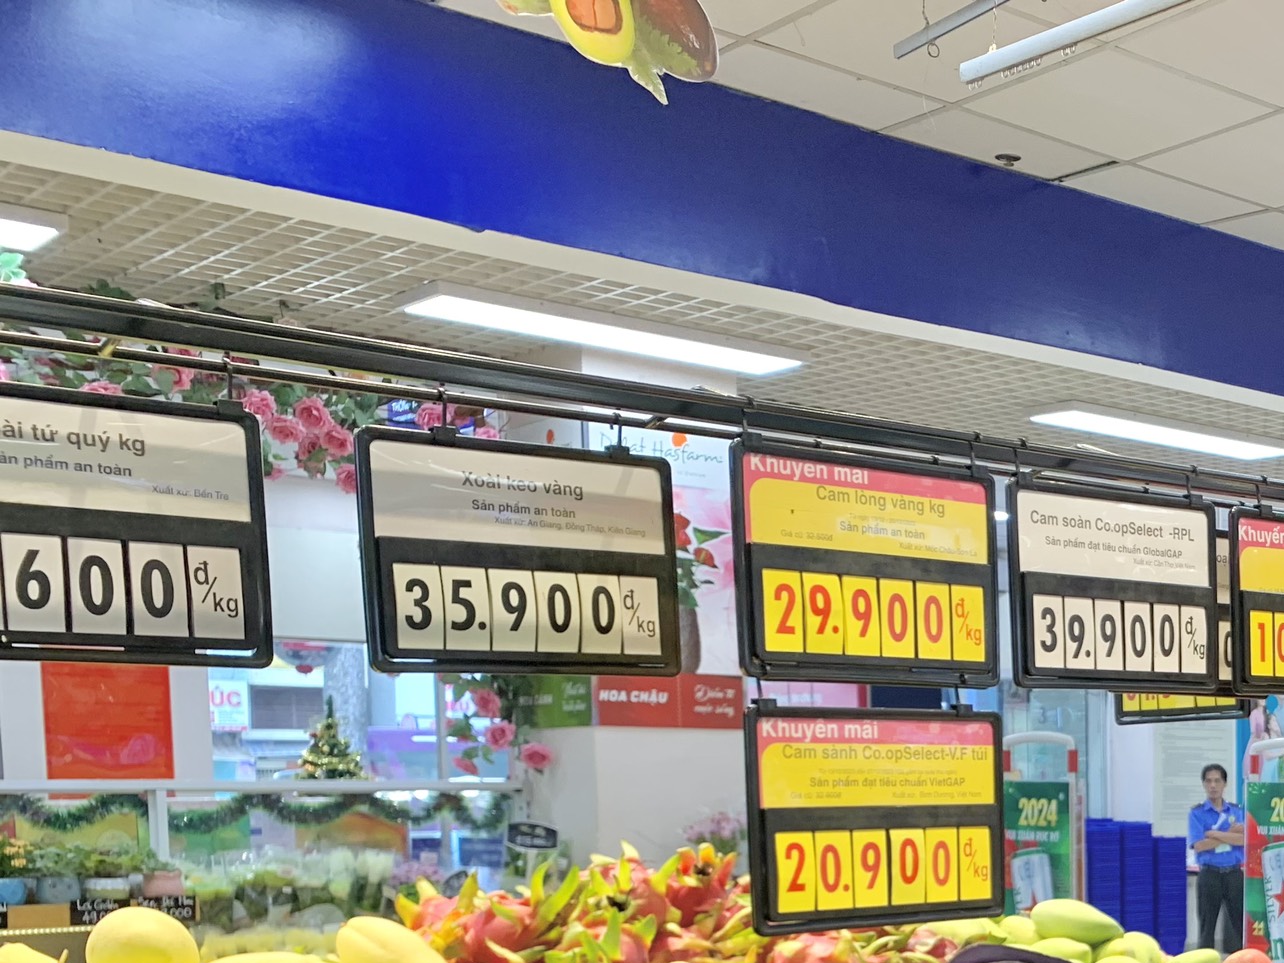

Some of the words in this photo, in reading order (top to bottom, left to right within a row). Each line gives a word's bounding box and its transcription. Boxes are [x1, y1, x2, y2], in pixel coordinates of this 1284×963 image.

[31, 424, 58, 443] tứ
[66, 431, 111, 452] quý
[118, 433, 146, 457] kg
[23, 455, 69, 470] phẩm
[73, 463, 94, 473] an
[97, 463, 132, 477] toàn
[462, 470, 501, 489] Xoài
[543, 480, 584, 501] vàng
[472, 499, 495, 511] Sản
[498, 501, 531, 516] phẩm
[533, 506, 549, 516] an
[551, 506, 576, 518] toàn
[816, 485, 850, 503] Cam
[855, 490, 886, 511] lòng
[891, 495, 924, 516] vàng
[929, 499, 945, 517] kg
[891, 528, 902, 537] an
[905, 528, 925, 539] toàn
[1030, 510, 1059, 526] Cam
[1062, 514, 1092, 530] soàn
[1095, 518, 1163, 538] Co.opSelect
[1143, 547, 1183, 559] GlobalGAP
[404, 578, 615, 635] 35.900
[774, 583, 943, 644] 29.900
[1040, 607, 1175, 659] 39.900
[600, 689, 627, 702] HOA
[631, 688, 668, 707] CHẬU
[782, 744, 818, 760] Cam
[822, 745, 857, 760] sành
[972, 747, 988, 760] túi
[929, 777, 966, 787] VietGAP
[1018, 797, 1058, 827] 2024
[785, 838, 950, 893] 20.900
